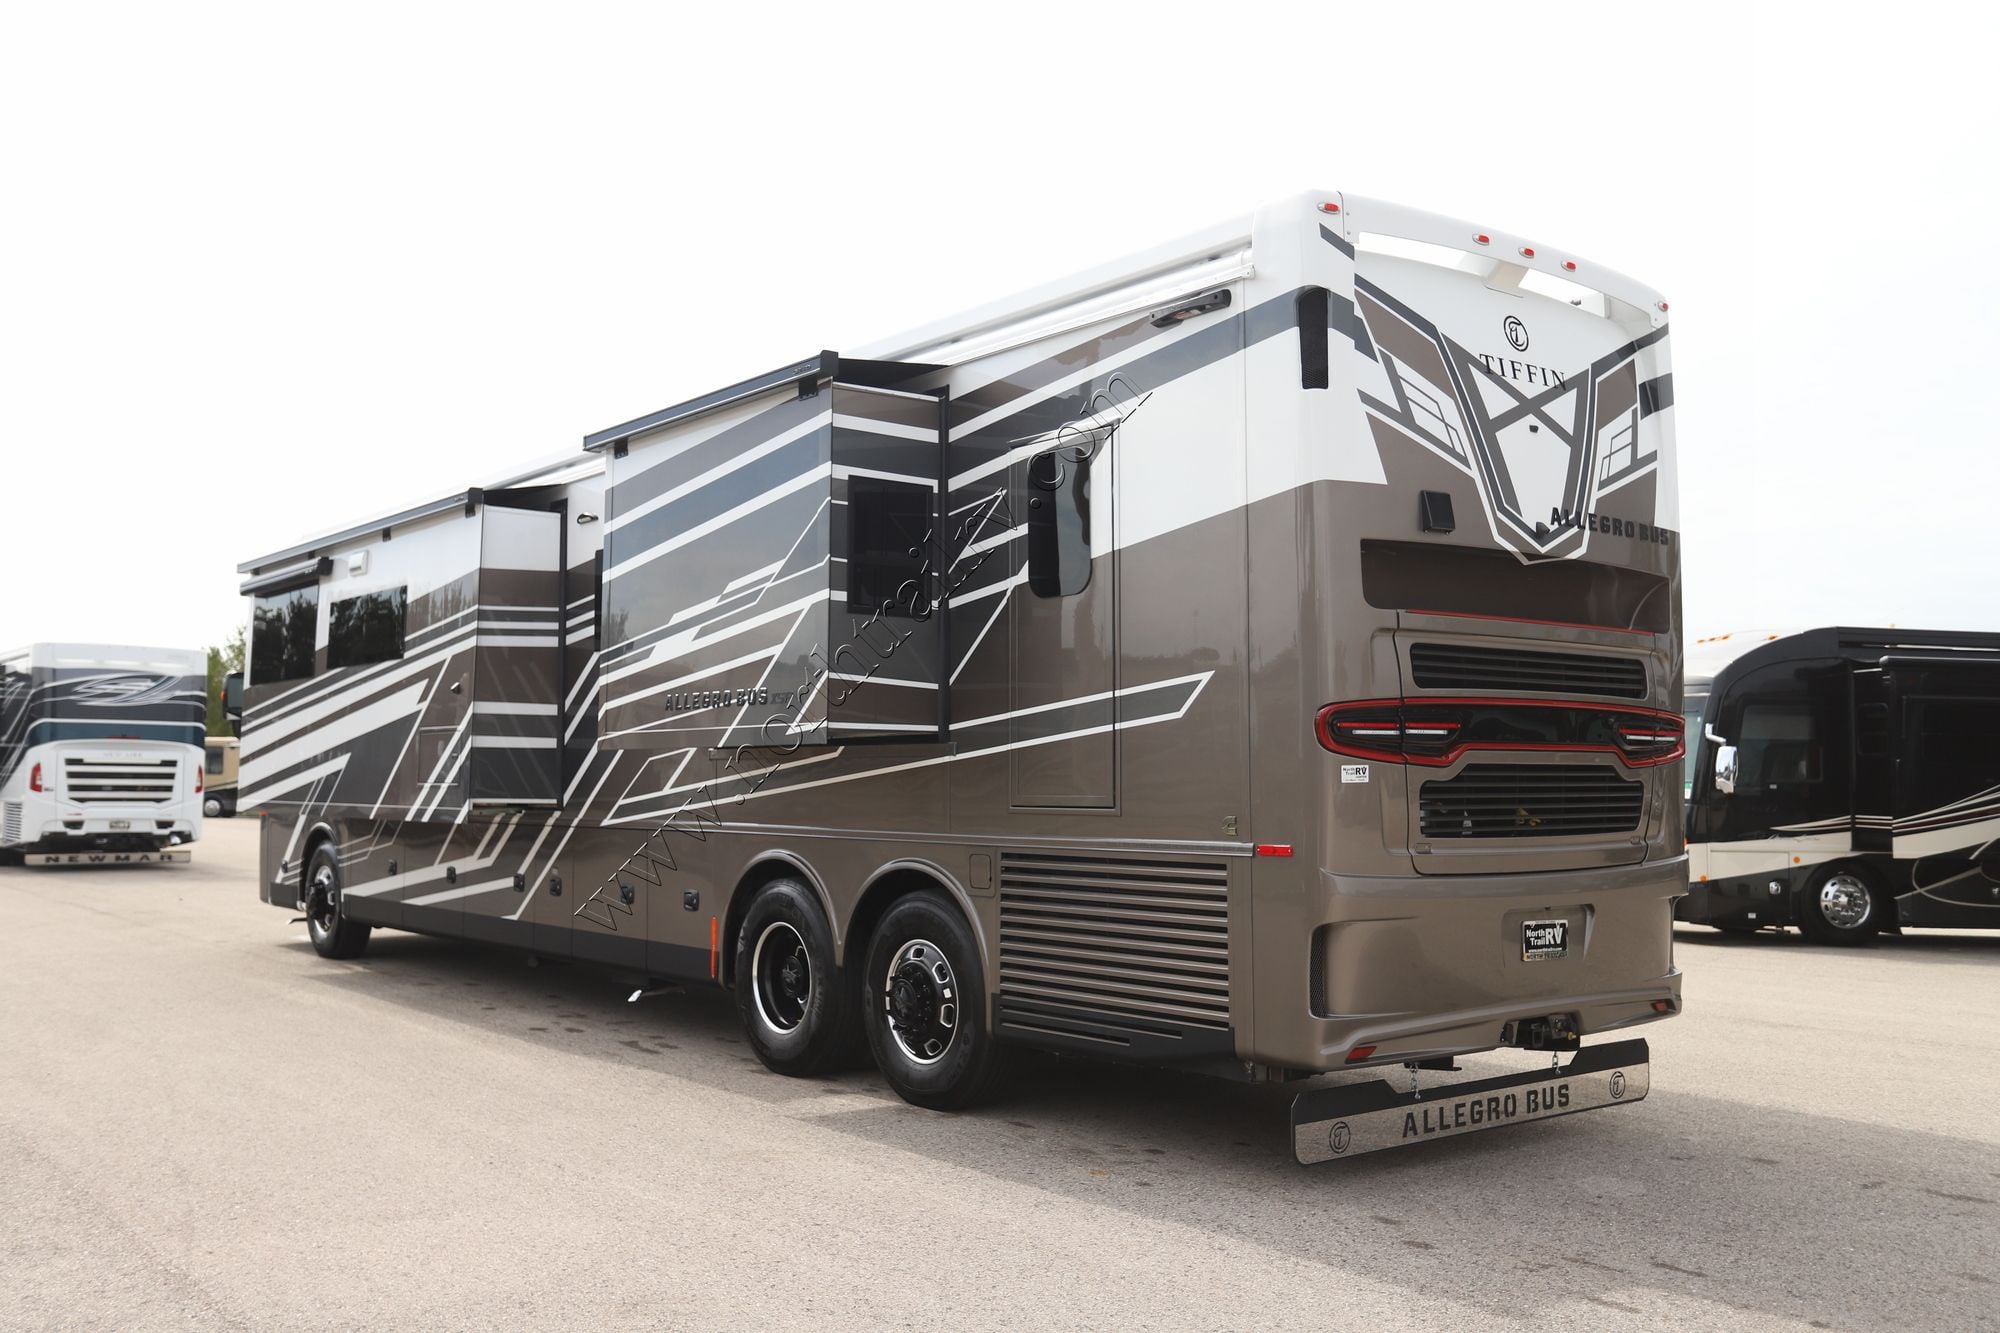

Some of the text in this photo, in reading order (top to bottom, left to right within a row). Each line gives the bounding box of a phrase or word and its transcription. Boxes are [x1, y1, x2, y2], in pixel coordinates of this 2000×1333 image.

[1479, 353, 1566, 391] TIFFIN
[1550, 507, 1670, 546] ALLEGRO BUS
[664, 689, 732, 711] ALLEGRO
[736, 686, 768, 706] BUS
[1356, 767, 1367, 775] RV
[44, 853, 173, 864] NEWMAR
[1526, 929, 1545, 938] North
[1529, 938, 1545, 946] Trail
[1545, 927, 1563, 945] RV
[1402, 1084, 1570, 1138] ALLEGRO BUS
